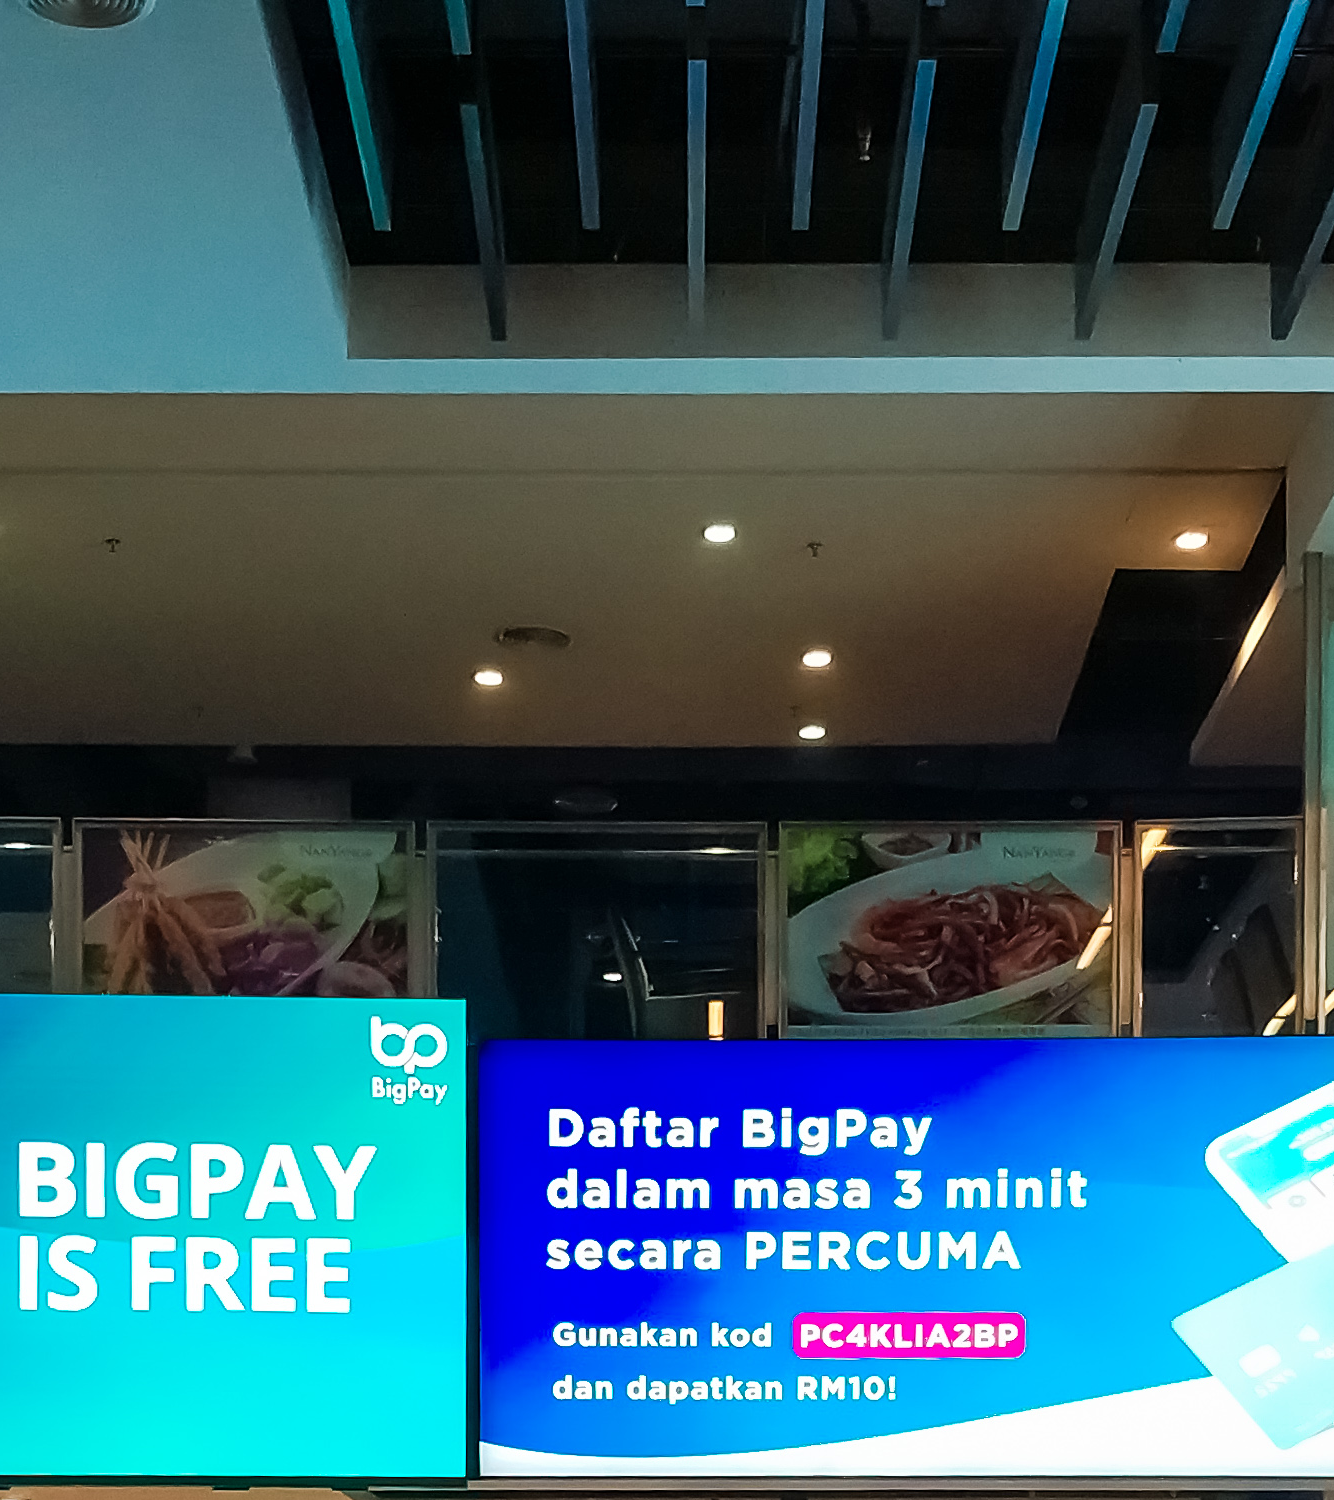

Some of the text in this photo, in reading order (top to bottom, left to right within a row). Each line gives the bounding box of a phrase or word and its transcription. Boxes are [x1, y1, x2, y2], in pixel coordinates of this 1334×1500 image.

[371, 1076, 448, 1105] BigPay
[547, 1107, 932, 1156] Daftar BigPay
[18, 1141, 378, 1220] BIGPAY
[546, 1167, 1088, 1210] dalam masa 3 minit
[546, 1231, 1021, 1272] secara PERCUMA
[18, 1235, 351, 1314] IS FREE
[553, 1322, 1019, 1349] Gunakan kod PC4KLIA2BP
[553, 1375, 898, 1405] dan dapatkan RM10!
